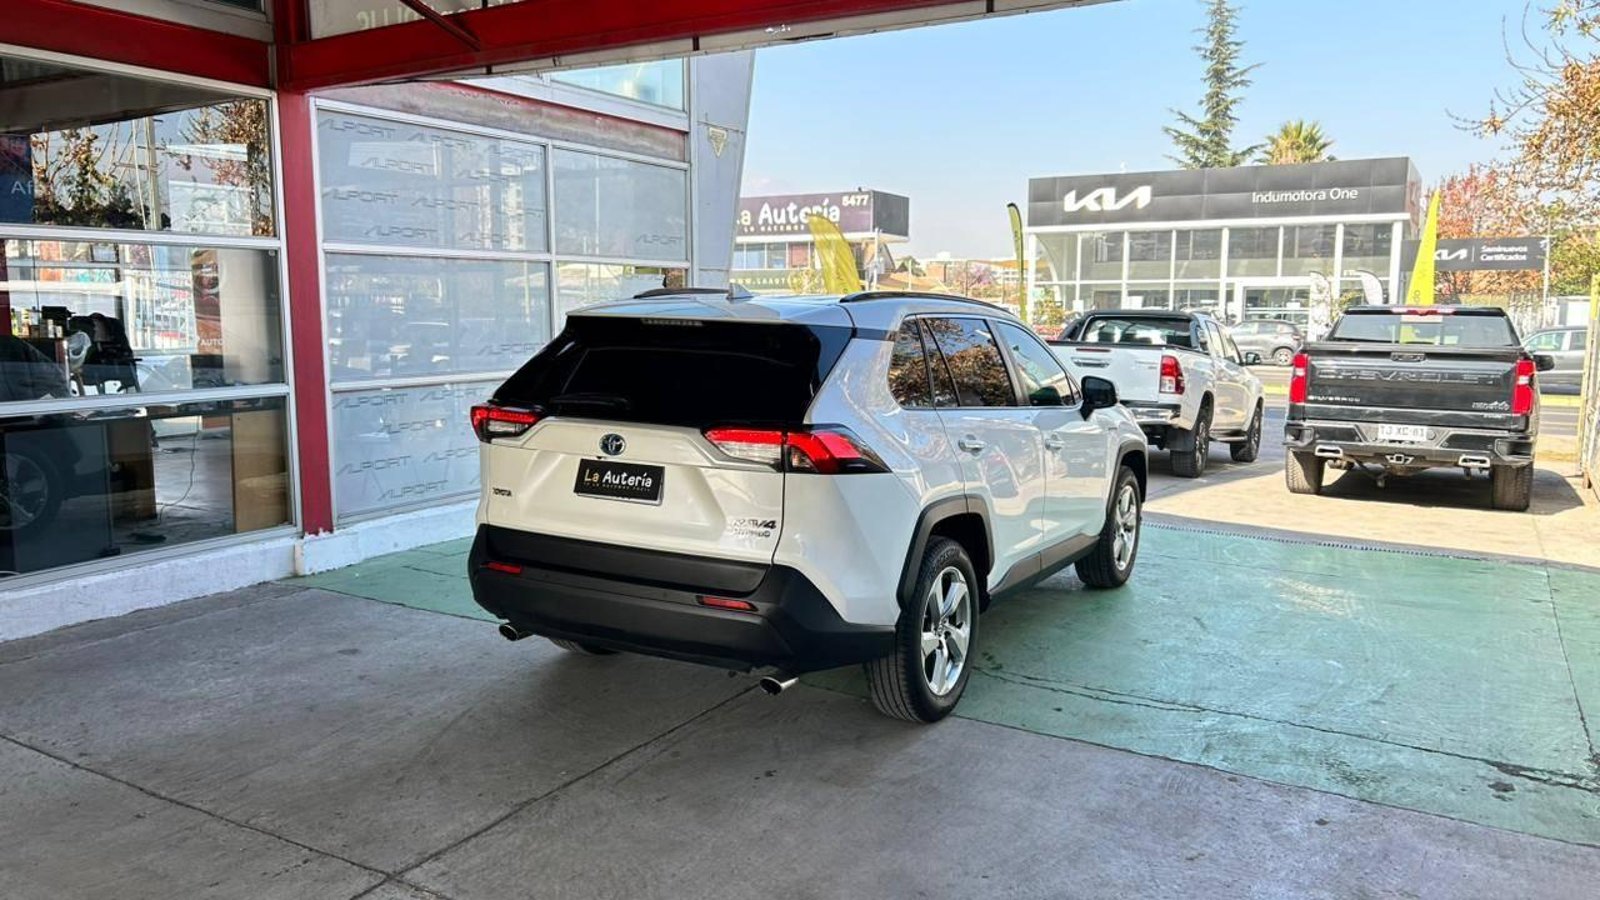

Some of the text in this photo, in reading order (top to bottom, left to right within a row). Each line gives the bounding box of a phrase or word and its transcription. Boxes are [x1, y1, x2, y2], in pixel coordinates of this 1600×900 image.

[1063, 185, 1152, 212] KIA
[1252, 187, 1359, 203] Indumotora One
[737, 197, 841, 226] a Autería
[1316, 368, 1504, 386] CHEVROLET
[583, 468, 653, 487] La Autería
